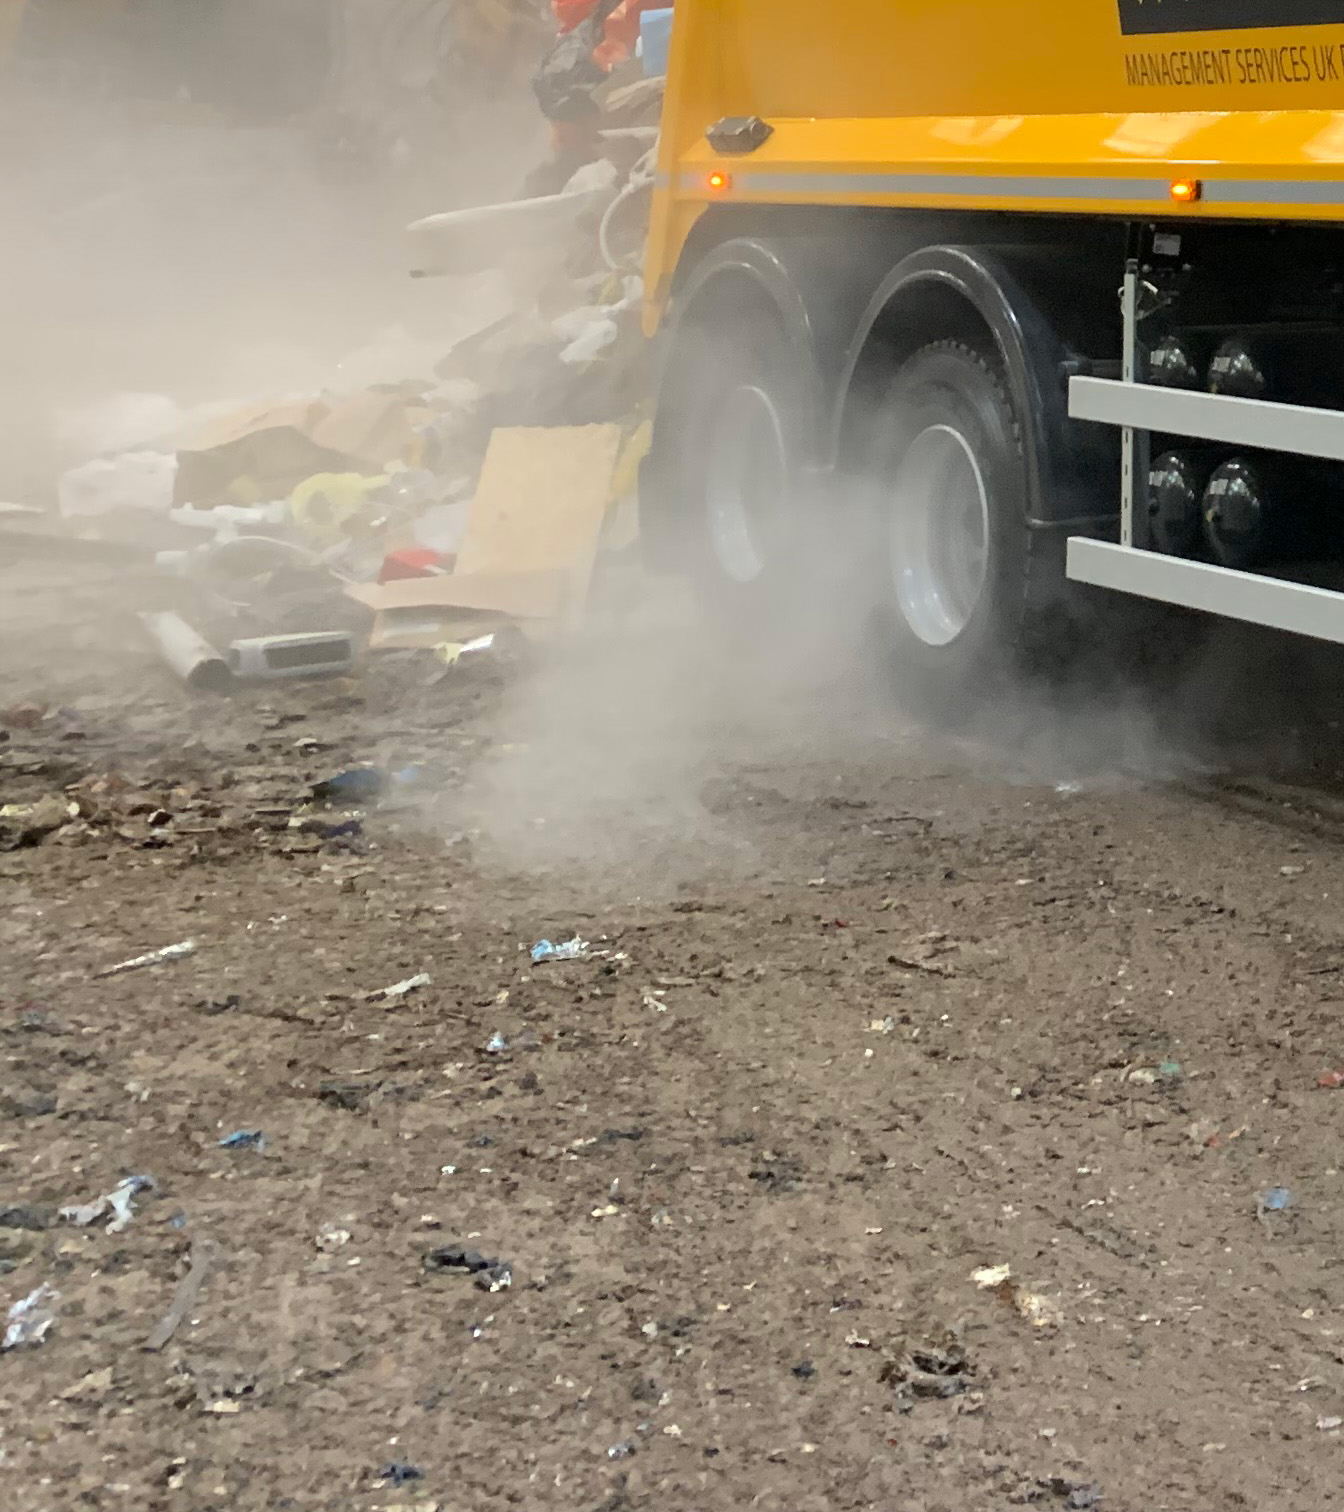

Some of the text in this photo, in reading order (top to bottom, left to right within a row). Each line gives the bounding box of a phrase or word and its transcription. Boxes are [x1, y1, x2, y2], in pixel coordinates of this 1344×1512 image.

[1125, 49, 1232, 86] MANAGEMENT
[1235, 45, 1310, 83] SERVICES
[1313, 43, 1339, 81] UK
